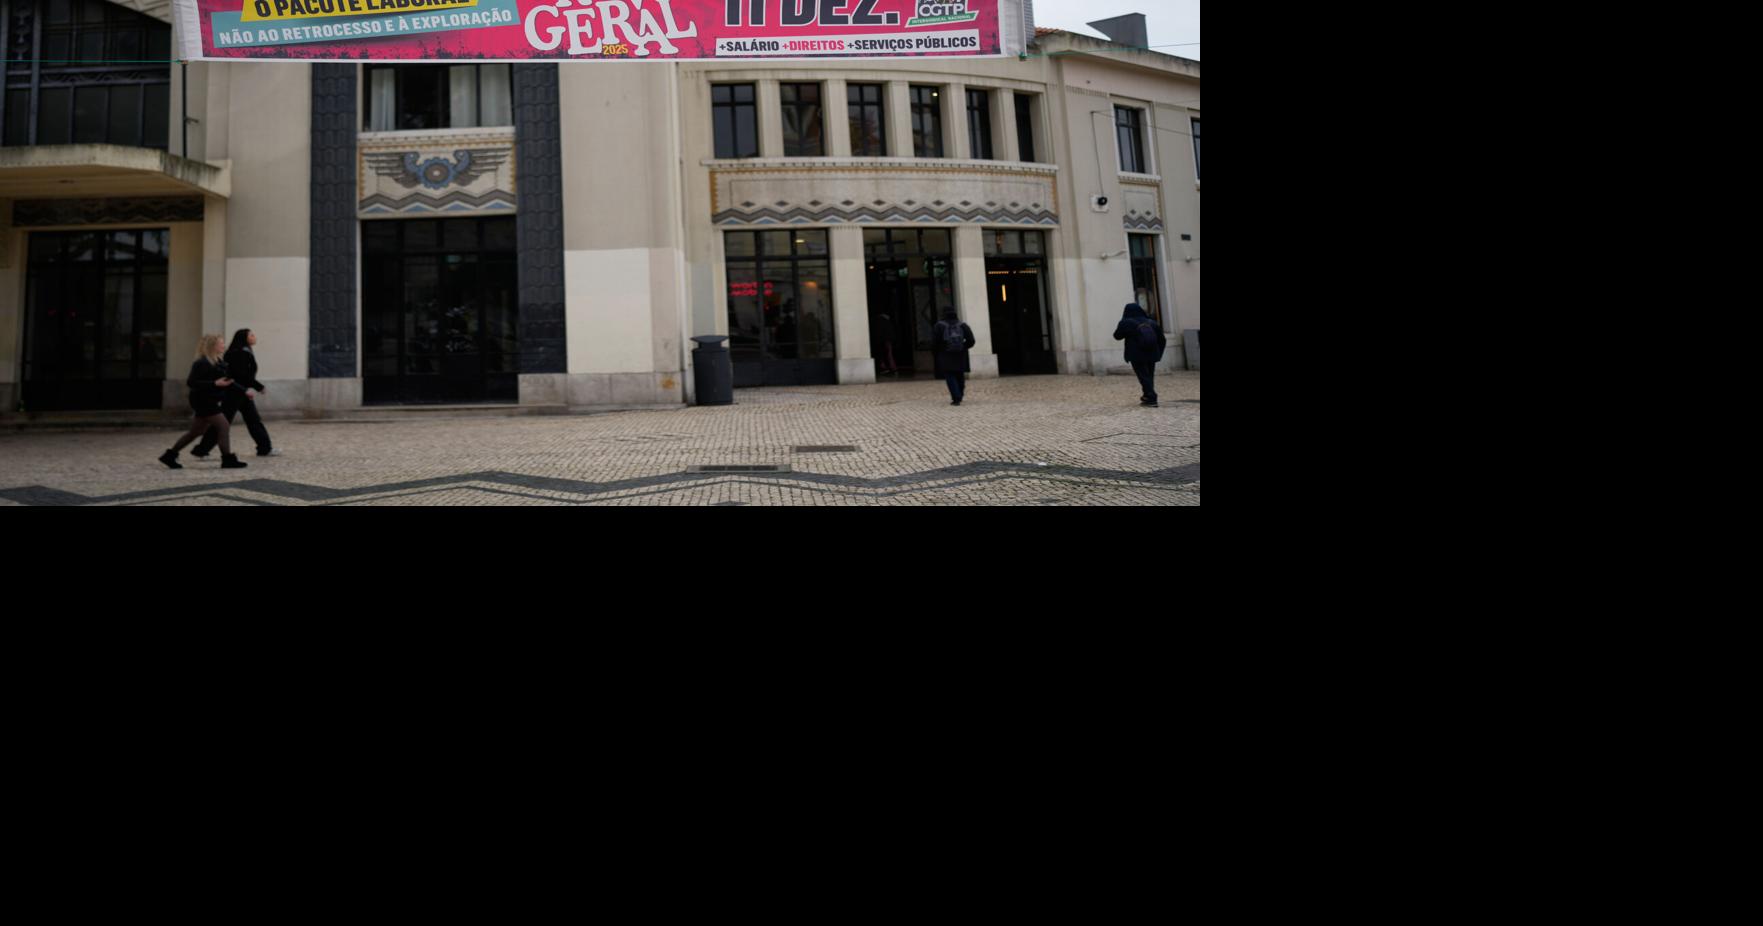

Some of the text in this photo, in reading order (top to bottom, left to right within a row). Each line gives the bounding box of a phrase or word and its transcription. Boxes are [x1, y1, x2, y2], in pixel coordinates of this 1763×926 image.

[255, 0, 271, 17] O
[918, 3, 964, 17] CGTP
[219, 8, 513, 45] NÃO AO RETROCESSO E À EXPLORAÇÃO
[524, 0, 697, 56] GERAL
[602, 44, 629, 55] 2025
[719, 36, 977, 52] +SALÁRIO +DIREITOS +SERVIÇOS PÚBLICOS
